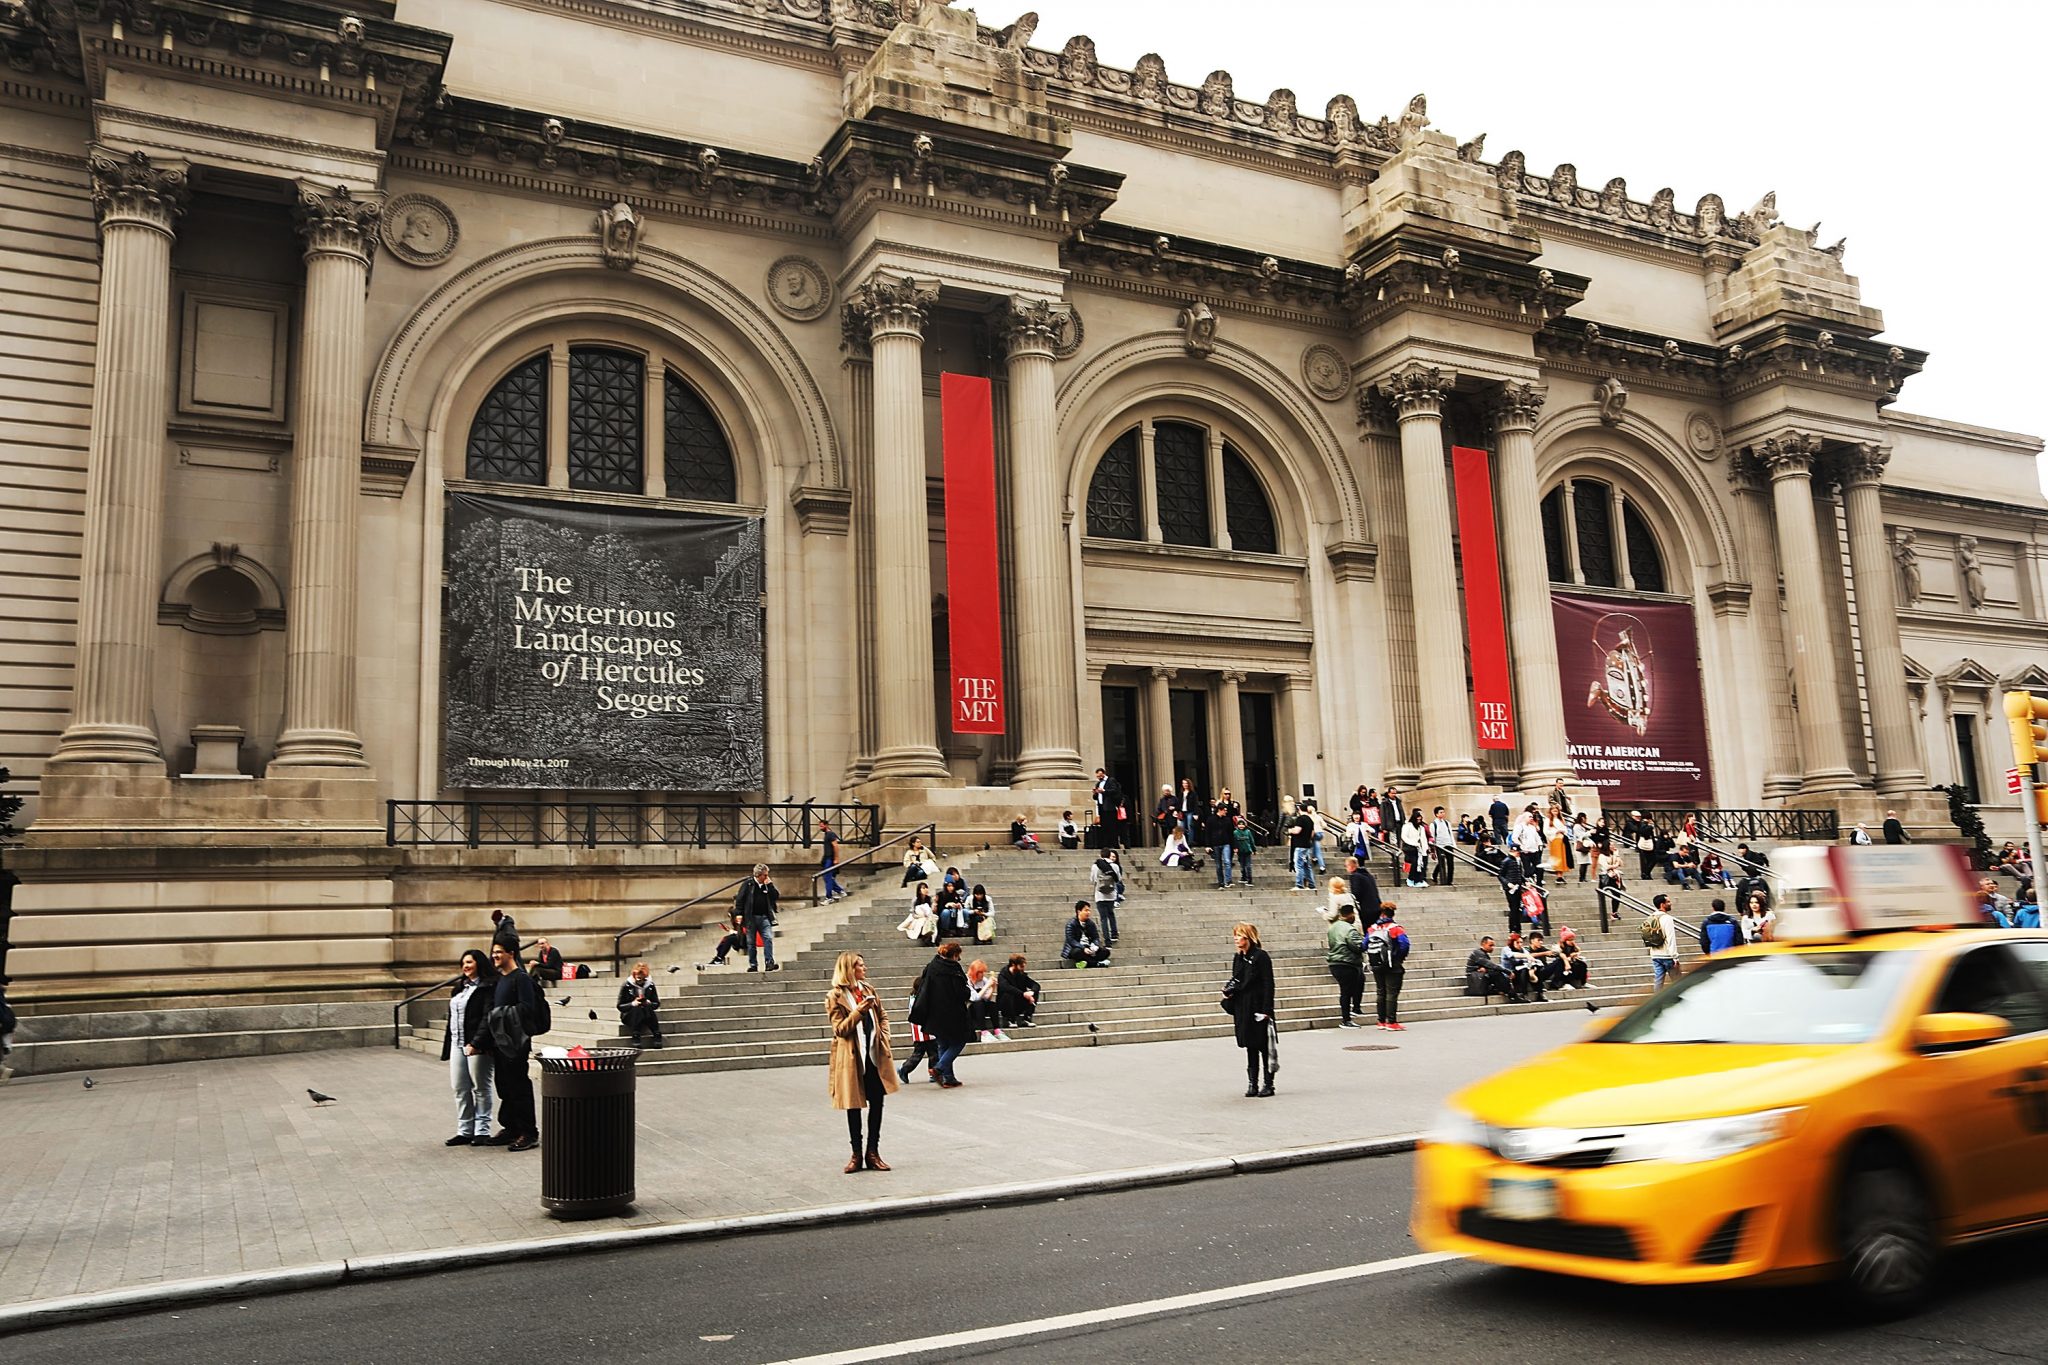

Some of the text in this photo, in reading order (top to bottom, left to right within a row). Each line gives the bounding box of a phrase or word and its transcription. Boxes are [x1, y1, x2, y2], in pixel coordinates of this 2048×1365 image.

[514, 566, 572, 595] The
[514, 596, 675, 629] Mysterious
[514, 625, 682, 661] Landscapes
[541, 654, 704, 687] of Hercules
[958, 677, 997, 700] THE
[597, 686, 689, 718] Segers
[958, 700, 999, 722] MET
[1479, 702, 1507, 721] THE
[1480, 721, 1509, 740] MET
[1605, 746, 1660, 758] AMERICAN
[468, 757, 570, 771] Through May 21, 2017
